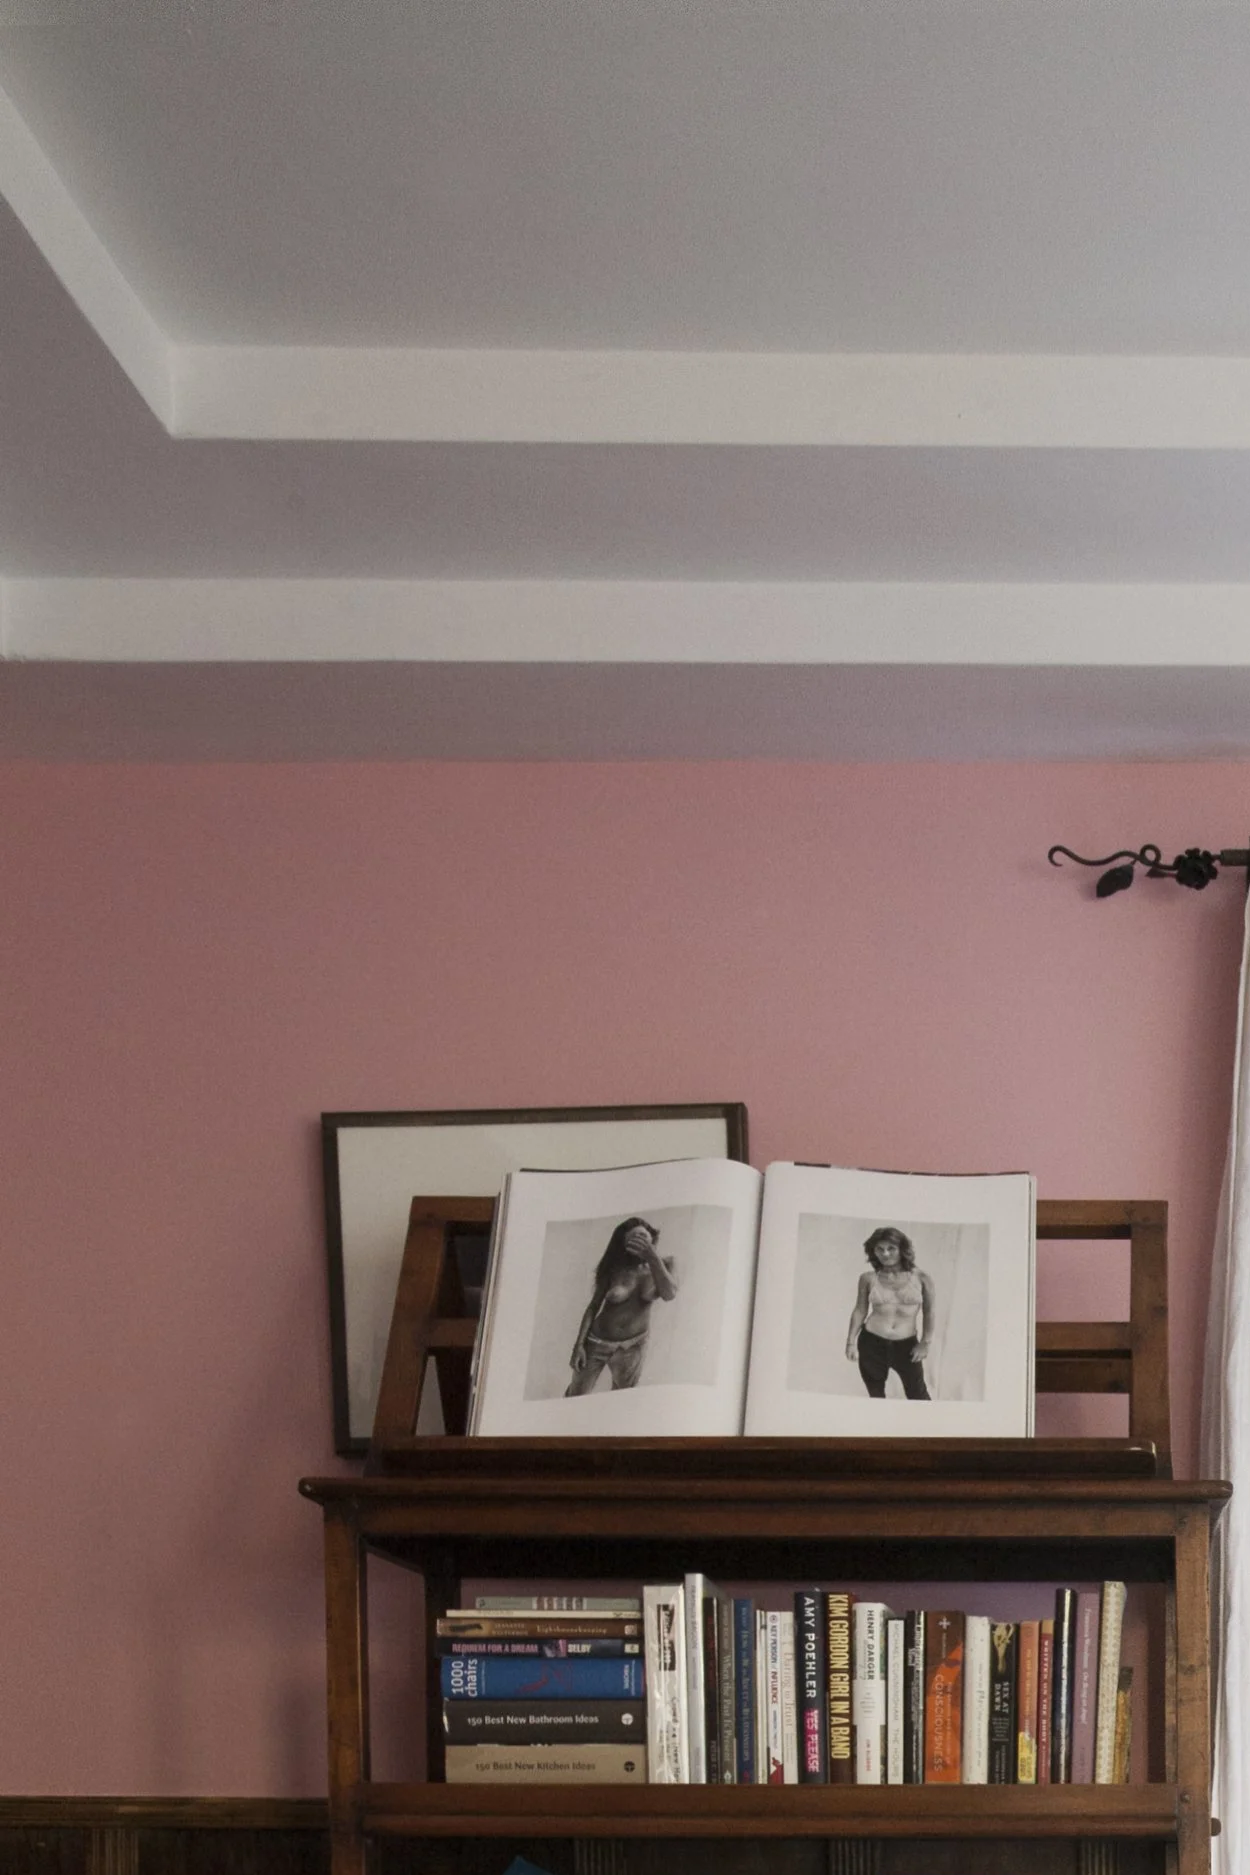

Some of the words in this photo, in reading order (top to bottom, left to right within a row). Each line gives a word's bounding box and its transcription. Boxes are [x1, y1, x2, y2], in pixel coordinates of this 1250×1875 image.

[804, 1596, 816, 1627] AMY
[829, 1594, 850, 1617] KIM
[867, 1609, 875, 1640] HENRY
[452, 1643, 485, 1653] REQUIEM
[487, 1643, 502, 1653] FOR
[511, 1643, 539, 1653] DREAM
[567, 1643, 591, 1653] SELBY
[829, 1619, 850, 1669] GORDON
[892, 1622, 900, 1660] MICHAEL
[451, 1660, 464, 1695] 1000
[465, 1658, 478, 1697] chairs
[782, 1652, 795, 1688] Daring
[804, 1632, 817, 1699] POEHLER
[867, 1643, 875, 1681] DARGER
[771, 1671, 779, 1704] INFLUENCE
[830, 1672, 851, 1699] GIRL
[892, 1661, 900, 1721] CUNNINGHAM
[1042, 1682, 1048, 1695] ON
[467, 1716, 482, 1726] 150
[484, 1715, 504, 1725] Best
[506, 1715, 526, 1725] New
[529, 1714, 573, 1724] Bathroom
[575, 1714, 599, 1724] Ideas
[806, 1708, 820, 1731] YES
[830, 1701, 850, 1714] IN
[830, 1716, 850, 1725] A
[933, 1674, 944, 1772] CONSCIOUSNESS
[1002, 1702, 1009, 1713] AT
[830, 1727, 851, 1760] BAND
[891, 1727, 900, 1743] THE
[475, 1762, 490, 1771] 150
[492, 1761, 512, 1770] Best
[515, 1761, 534, 1770] New
[536, 1760, 570, 1770] Kitchen
[572, 1760, 596, 1770] Ideas
[806, 1734, 820, 1773] PLEASE
[891, 1747, 900, 1777] HOURS
